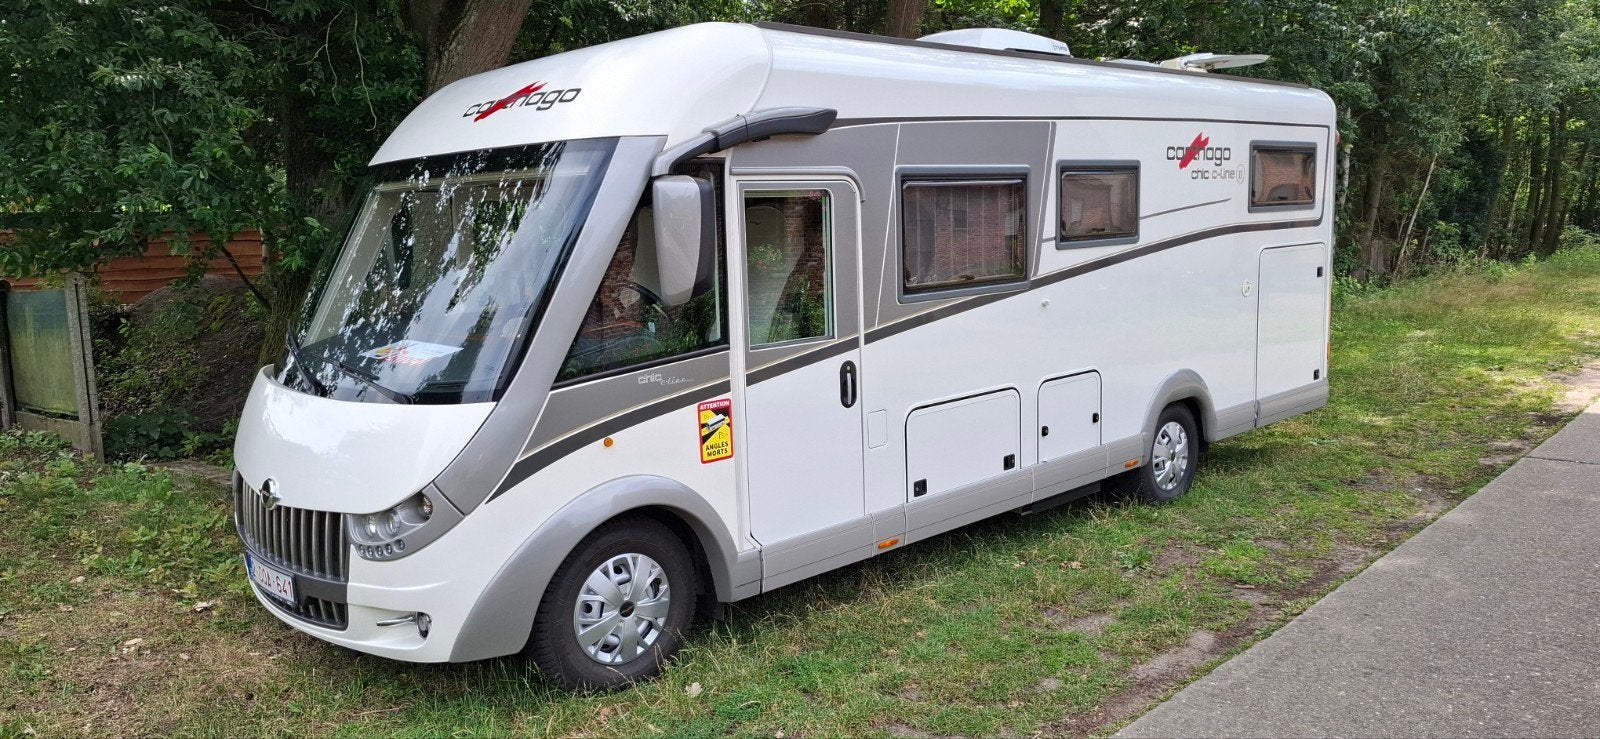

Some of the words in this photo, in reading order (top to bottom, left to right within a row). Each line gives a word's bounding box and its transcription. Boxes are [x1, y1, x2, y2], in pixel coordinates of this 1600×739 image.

[1191, 168, 1210, 180] chic
[637, 373, 663, 385] chic
[699, 400, 730, 410] ATTENTION
[705, 440, 729, 452] ANGLES
[706, 448, 728, 458] MORTS
